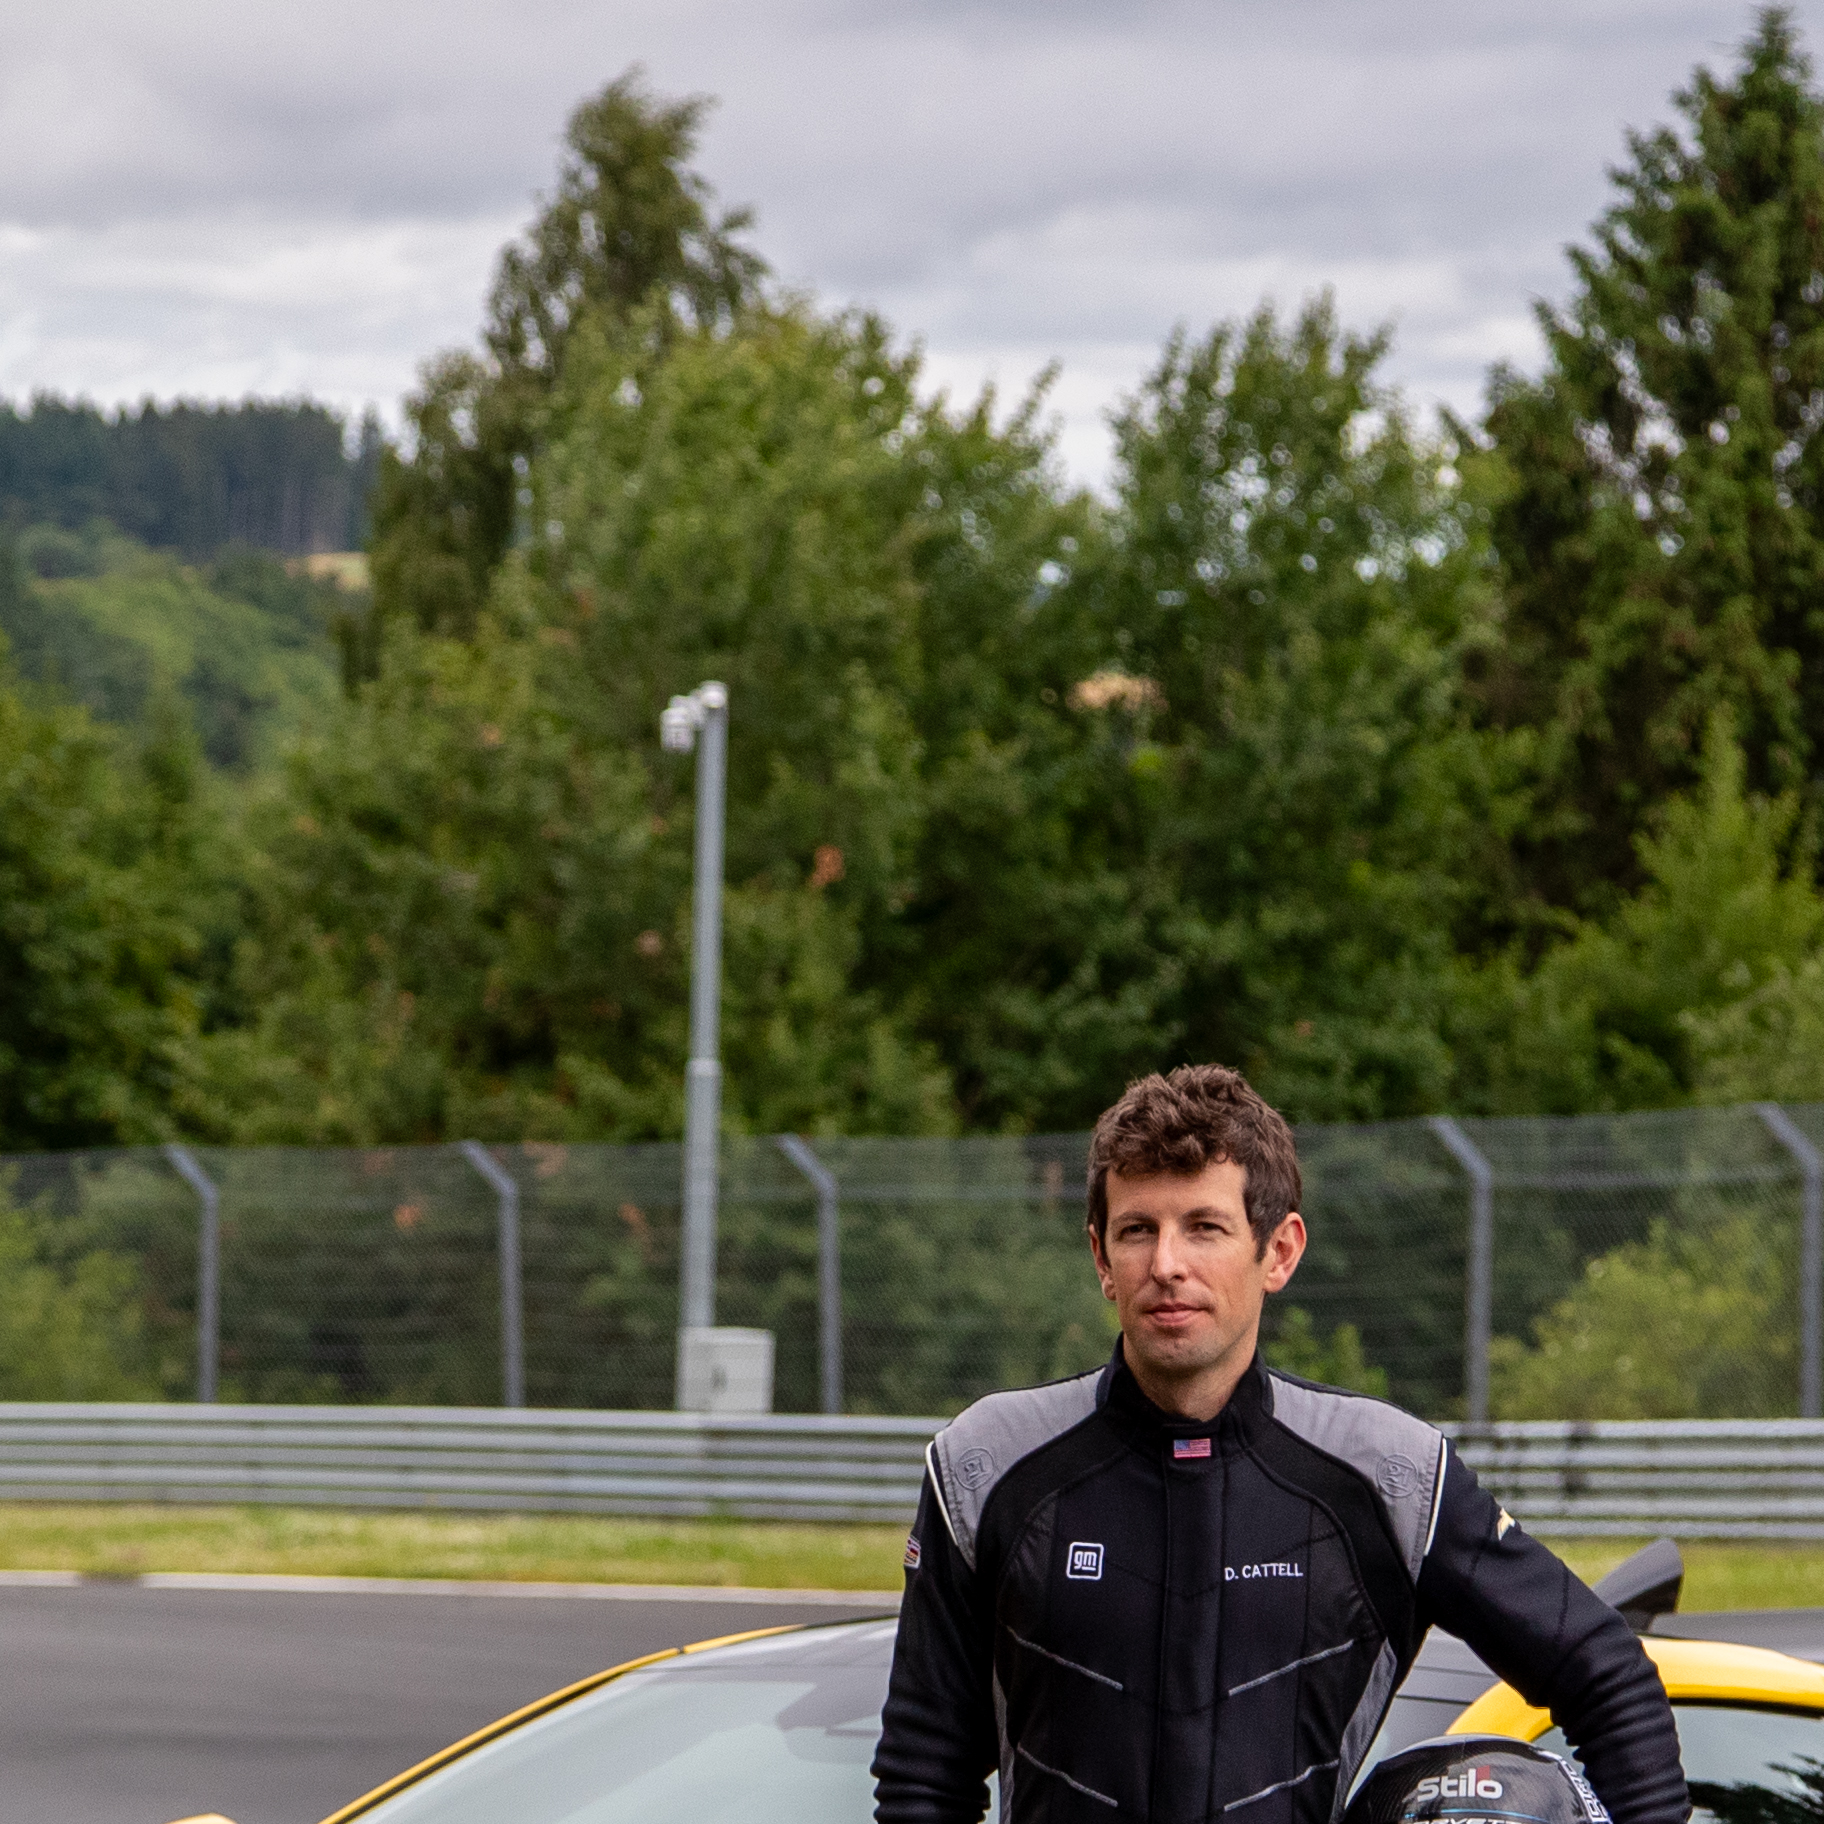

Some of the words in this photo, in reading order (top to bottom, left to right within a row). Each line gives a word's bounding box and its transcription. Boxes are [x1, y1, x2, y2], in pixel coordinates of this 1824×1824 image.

[1073, 1550, 1098, 1571] gm
[1224, 1566, 1239, 1582] D.
[1242, 1562, 1304, 1579] CATTELL
